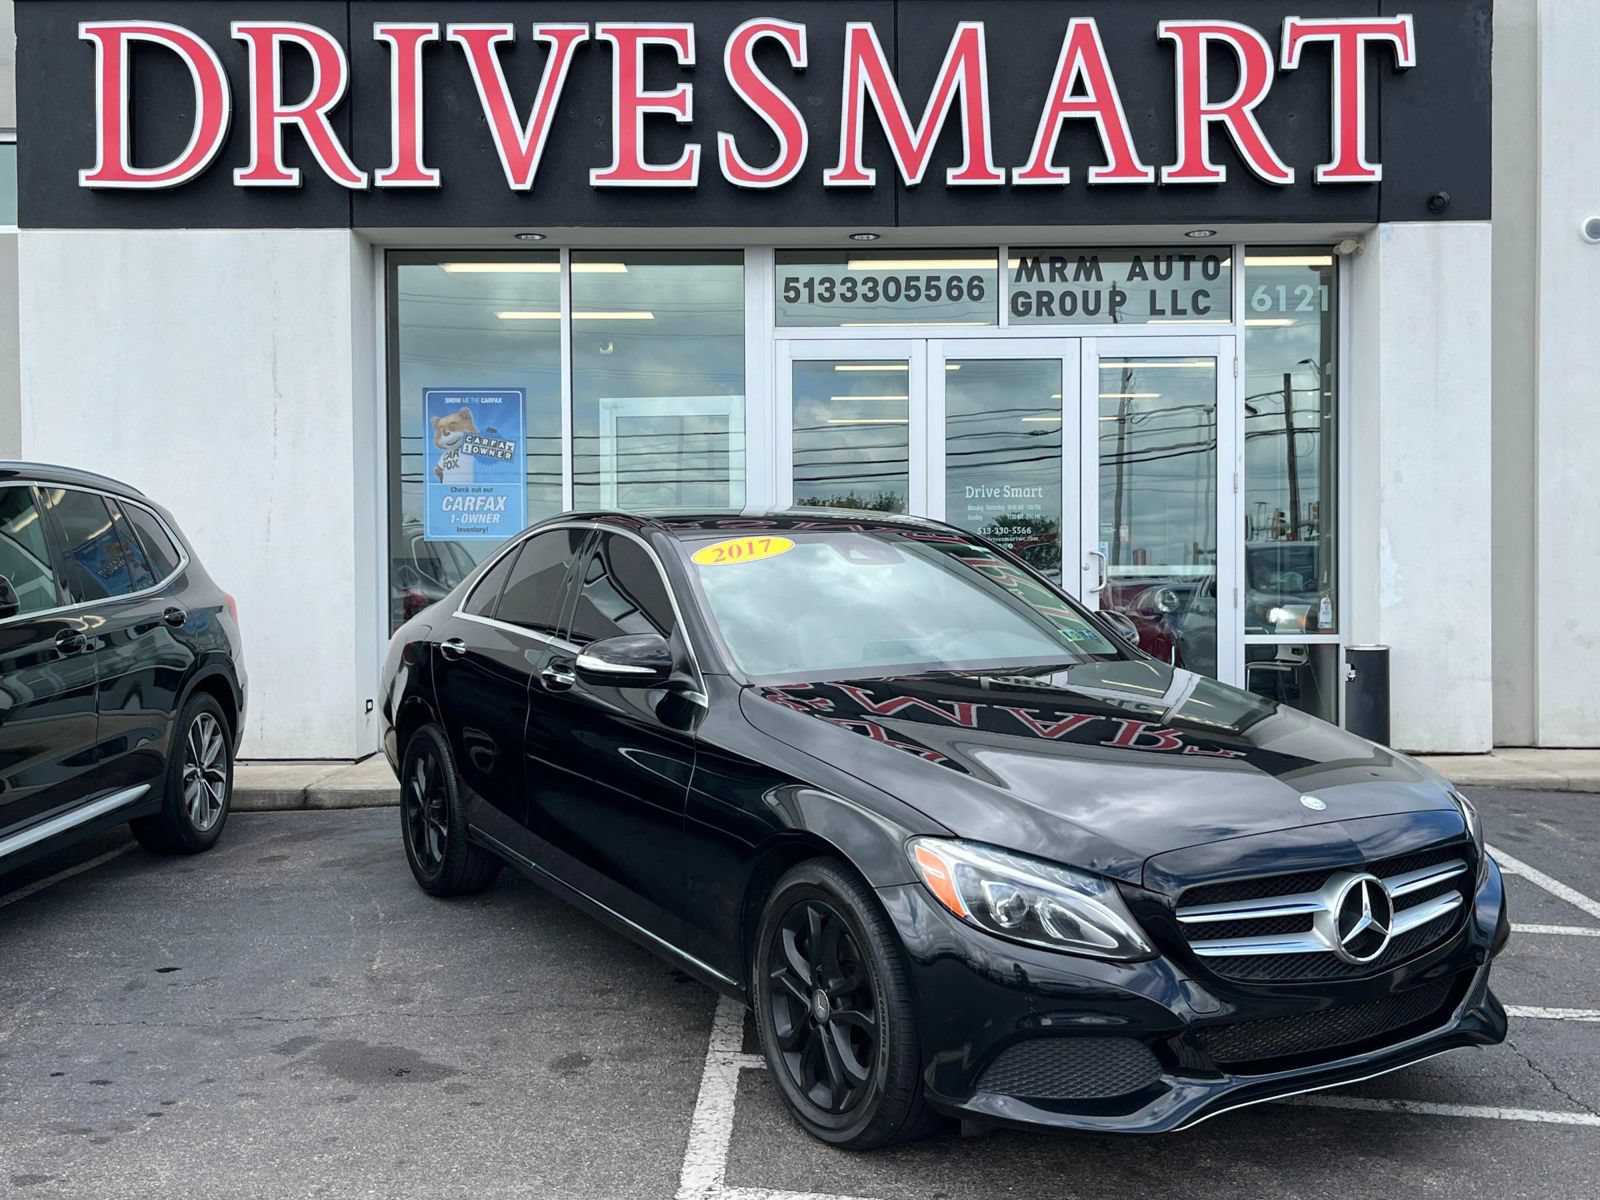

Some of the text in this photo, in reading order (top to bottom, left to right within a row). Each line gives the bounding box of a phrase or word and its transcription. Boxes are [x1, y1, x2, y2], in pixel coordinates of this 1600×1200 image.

[78, 13, 1417, 192] DRIVESMART
[1013, 254, 1222, 284] MRM AUTO
[783, 275, 986, 304] 5133305566
[1249, 284, 1329, 313] 6121
[1010, 288, 1212, 318] GROUP LLC
[464, 435, 514, 451] CARFAX
[443, 459, 460, 470] FOX
[442, 496, 507, 511] CARFAX
[965, 485, 1043, 498] Drive Smart
[977, 526, 1032, 535] 513-330-5566
[711, 538, 773, 563] 2017
